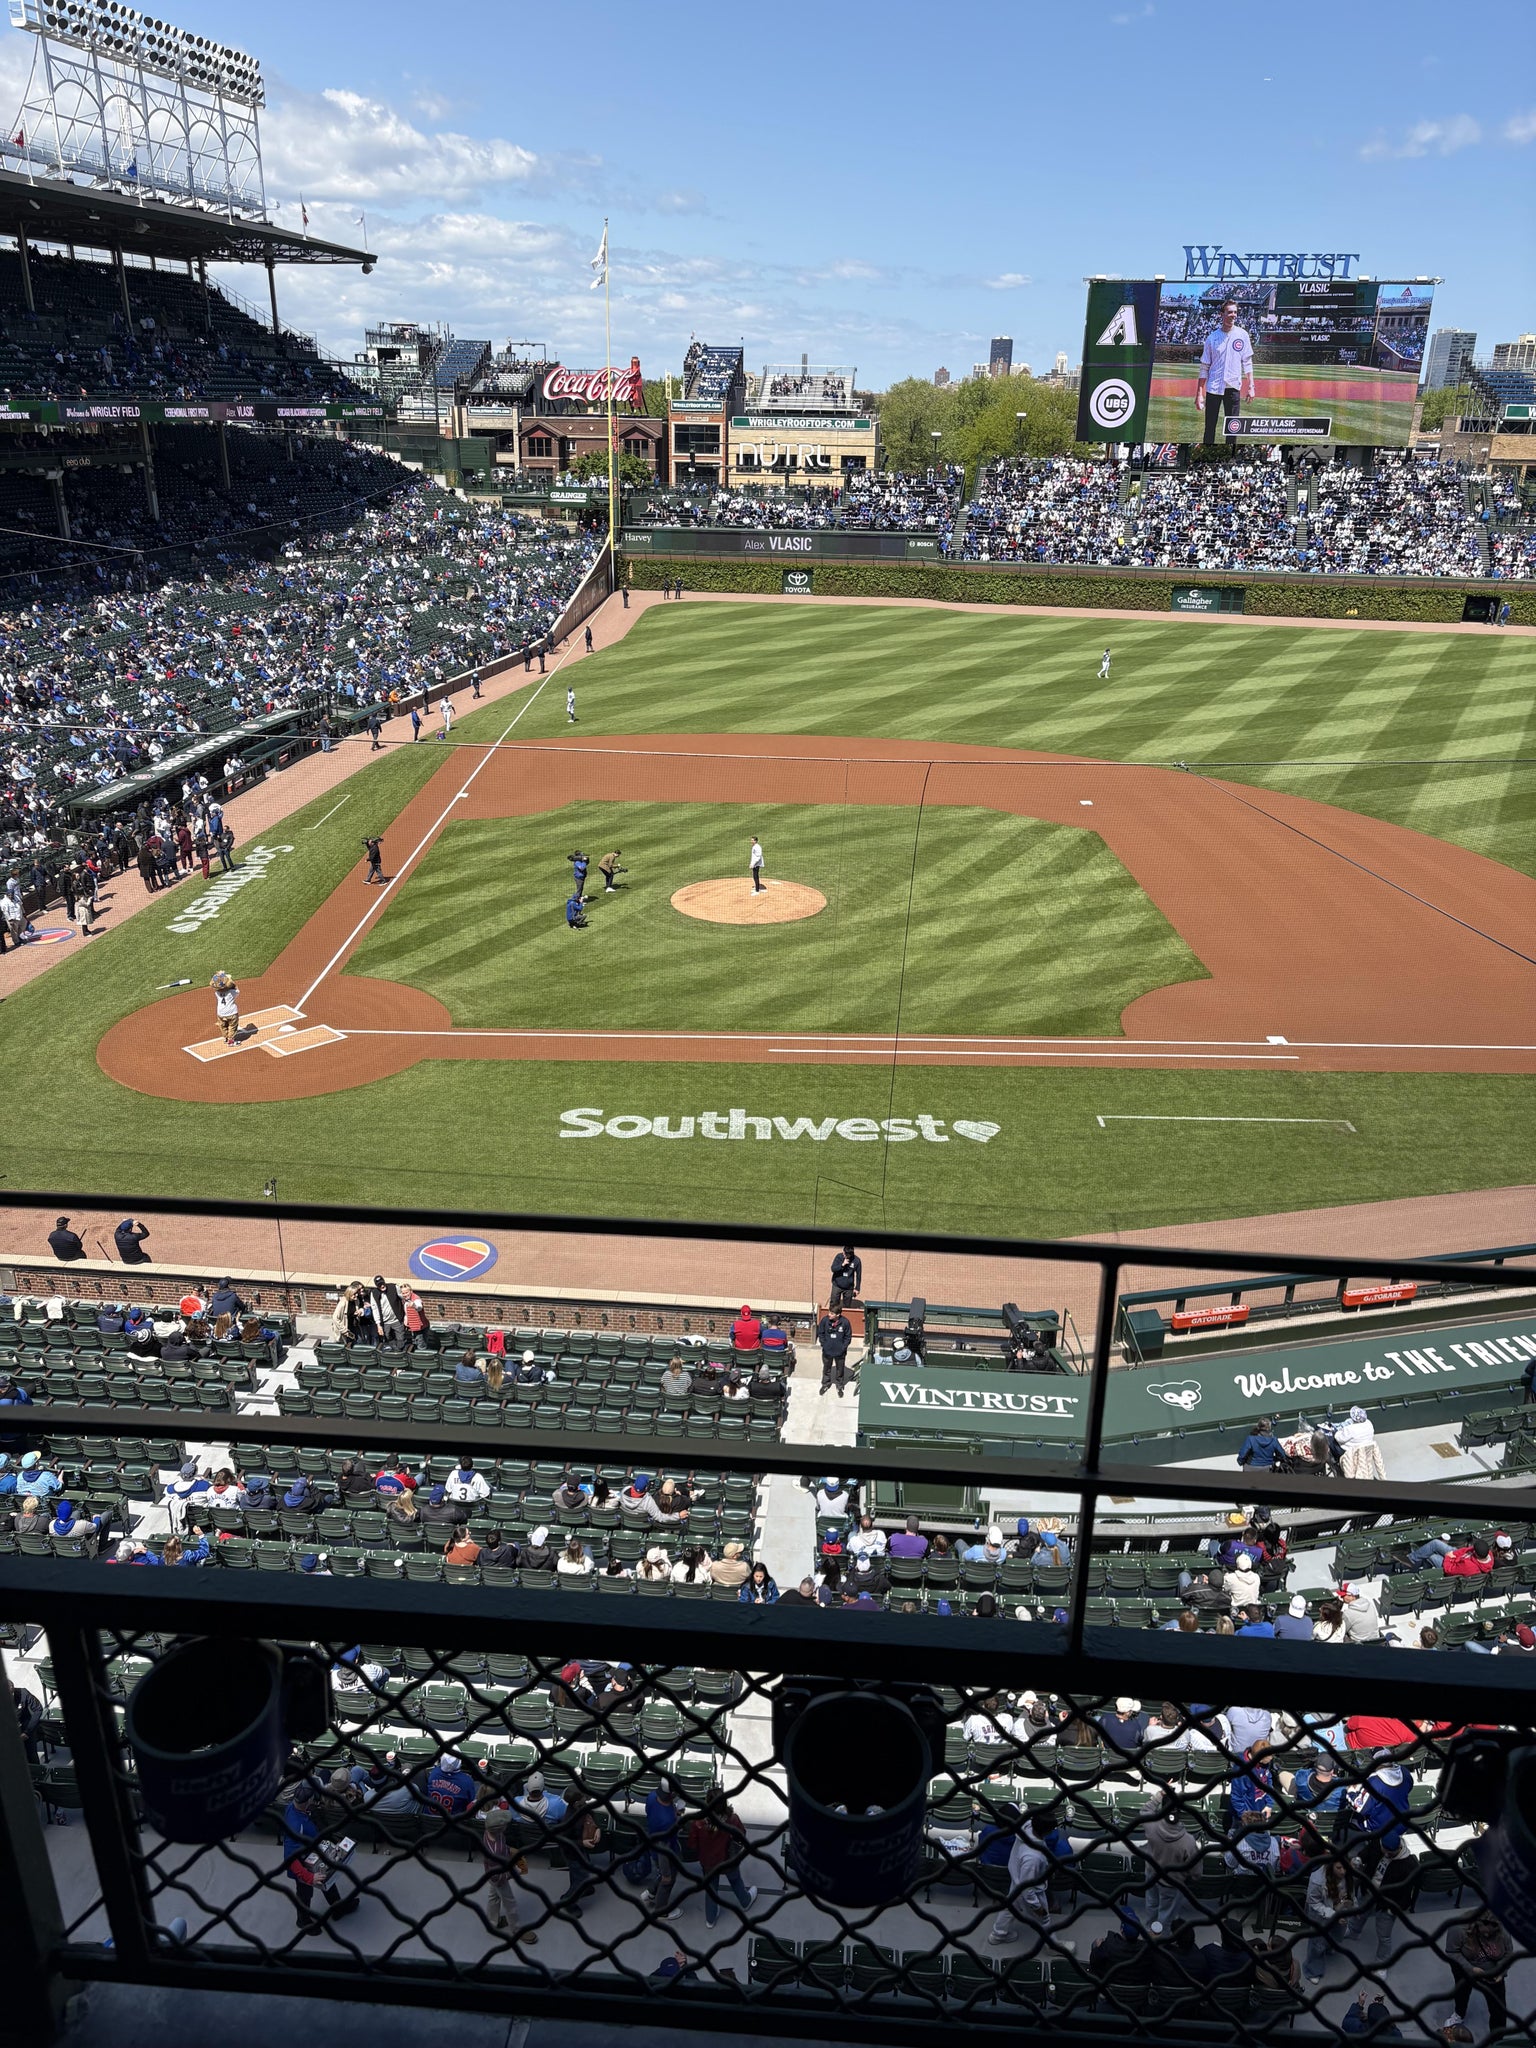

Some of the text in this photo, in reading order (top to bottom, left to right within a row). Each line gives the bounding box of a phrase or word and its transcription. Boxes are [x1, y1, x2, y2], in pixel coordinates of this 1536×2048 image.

[1182, 245, 1360, 279] WINTRUST
[1310, 334, 1330, 342] VLASIC
[90, 406, 121, 418] WRIGLEY
[121, 406, 141, 418] FIELD
[225, 406, 255, 417] Alex VLASIC
[748, 417, 856, 429] WRIGLEYROOFTOPS.COM
[1251, 419, 1296, 428] ALEX VLASIC
[624, 533, 652, 543] Harvey
[744, 537, 812, 551] Alex VLASIC
[784, 586, 811, 594] TOYOTA
[1177, 596, 1213, 605] Gallagher
[172, 844, 295, 922] Southwest
[558, 1107, 949, 1143] Southwest
[1191, 1313, 1233, 1325] GATORADE
[1234, 1367, 1362, 1399] Welcome
[1362, 1361, 1395, 1382] to
[1384, 1346, 1457, 1377] THE
[879, 1381, 1075, 1414] WINTRUST
[459, 1487, 468, 1501] 3
[1326, 1728, 1337, 1748] 2
